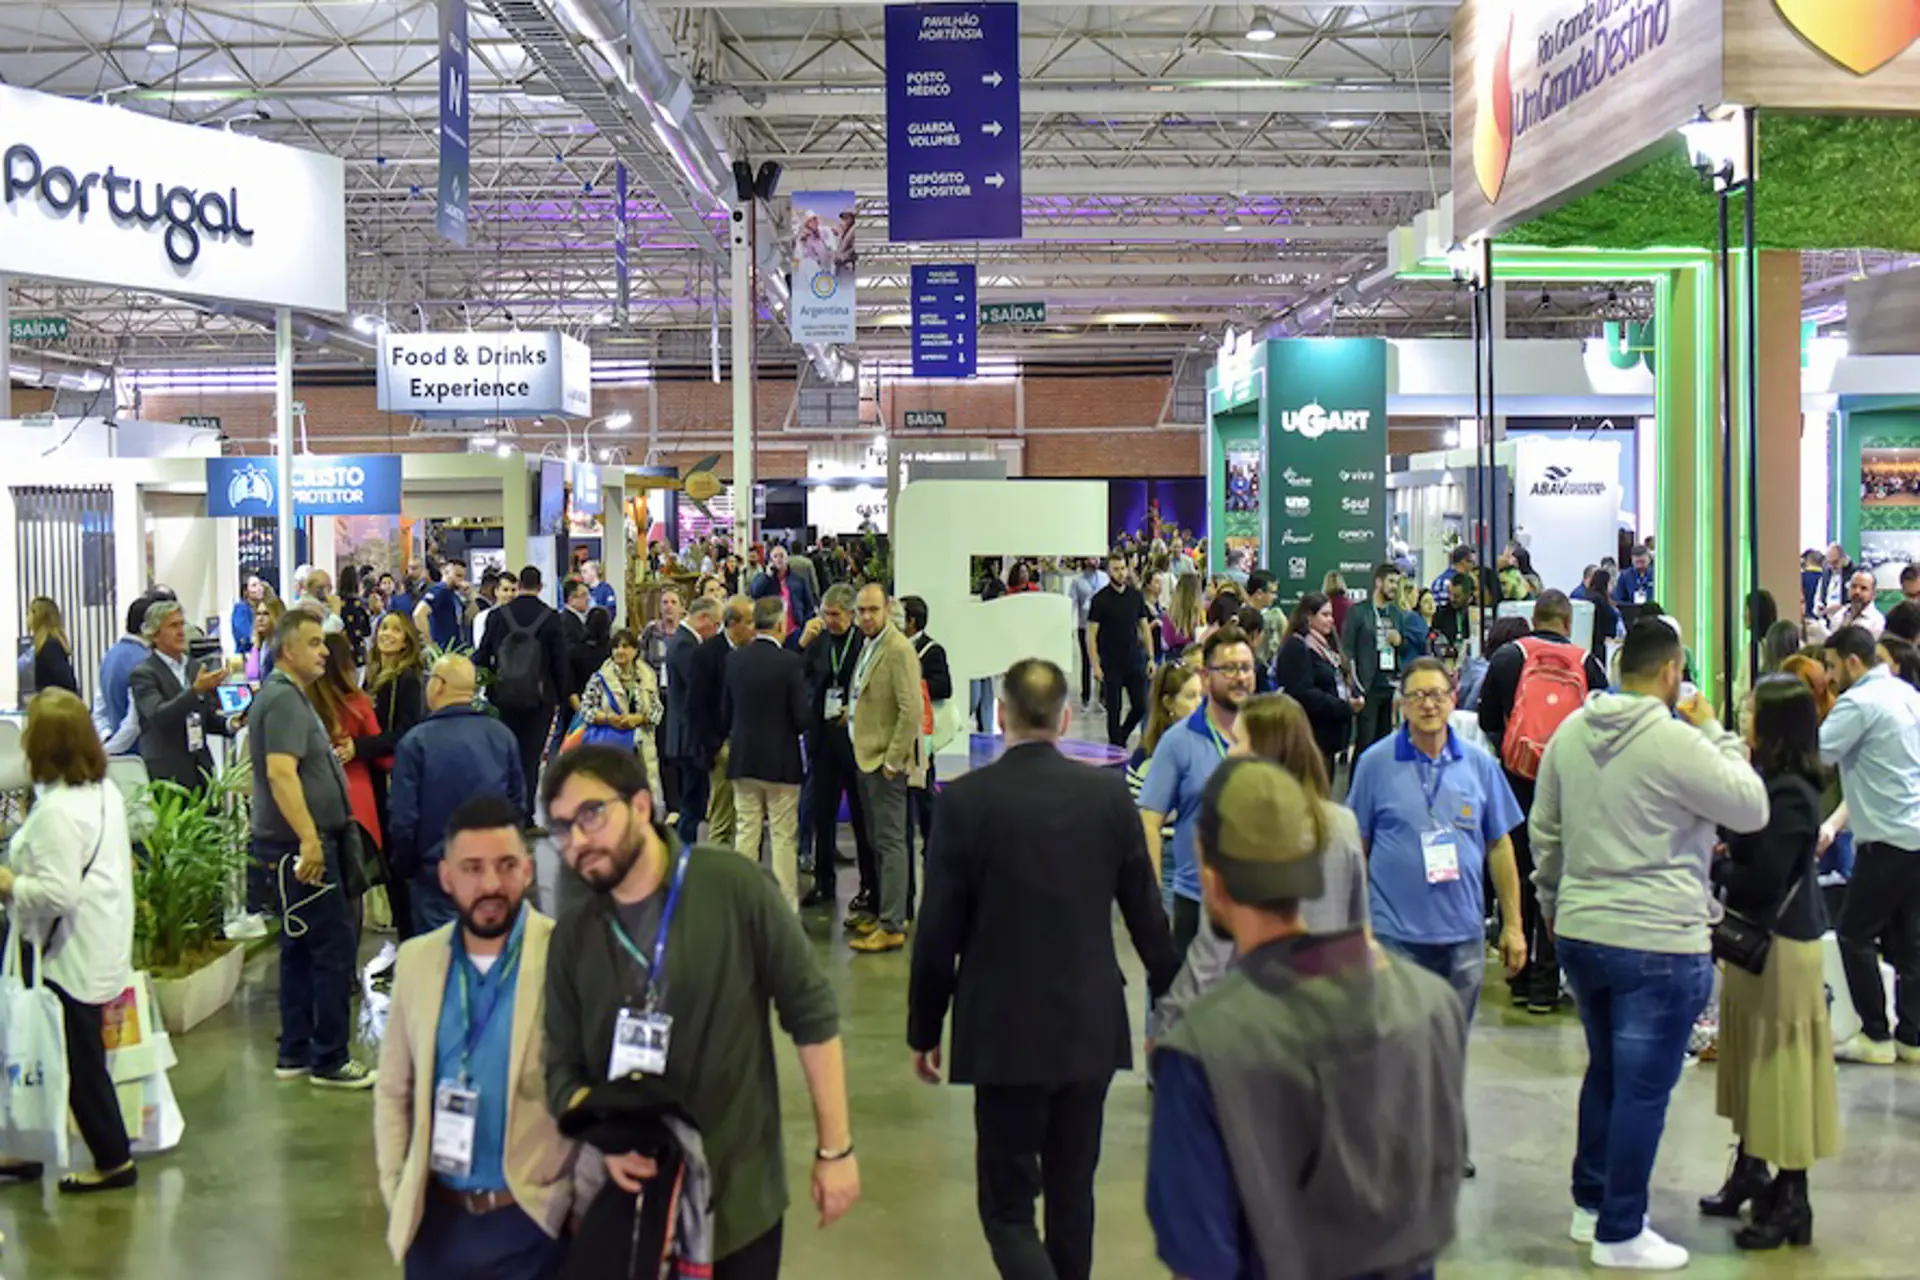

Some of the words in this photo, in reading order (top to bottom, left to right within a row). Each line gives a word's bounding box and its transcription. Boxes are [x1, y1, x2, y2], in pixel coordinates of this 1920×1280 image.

[923, 12, 980, 28] PAVILHÃO
[918, 26, 984, 41] HORTÊNSIA
[1555, 0, 1595, 55] Grande
[906, 71, 946, 84] POSTO
[906, 83, 952, 96] MÉDICO
[907, 121, 956, 134] GUARDA
[908, 134, 962, 147] VOLUMES
[909, 171, 965, 185] DEPÓSITO
[909, 185, 972, 198] EXPOSITOR
[4, 143, 254, 265] Portugal
[800, 305, 849, 319] Argentina
[990, 305, 1036, 323] SAÍDA
[12, 321, 60, 337] SAÍDA
[392, 347, 447, 366] Food
[453, 347, 469, 366] &
[478, 345, 548, 365] Drinks
[410, 377, 530, 404] Experience
[906, 413, 945, 426] SAÍDA
[1281, 402, 1371, 439] UGART
[1351, 469, 1375, 481] viva
[1341, 497, 1370, 511] Soul
